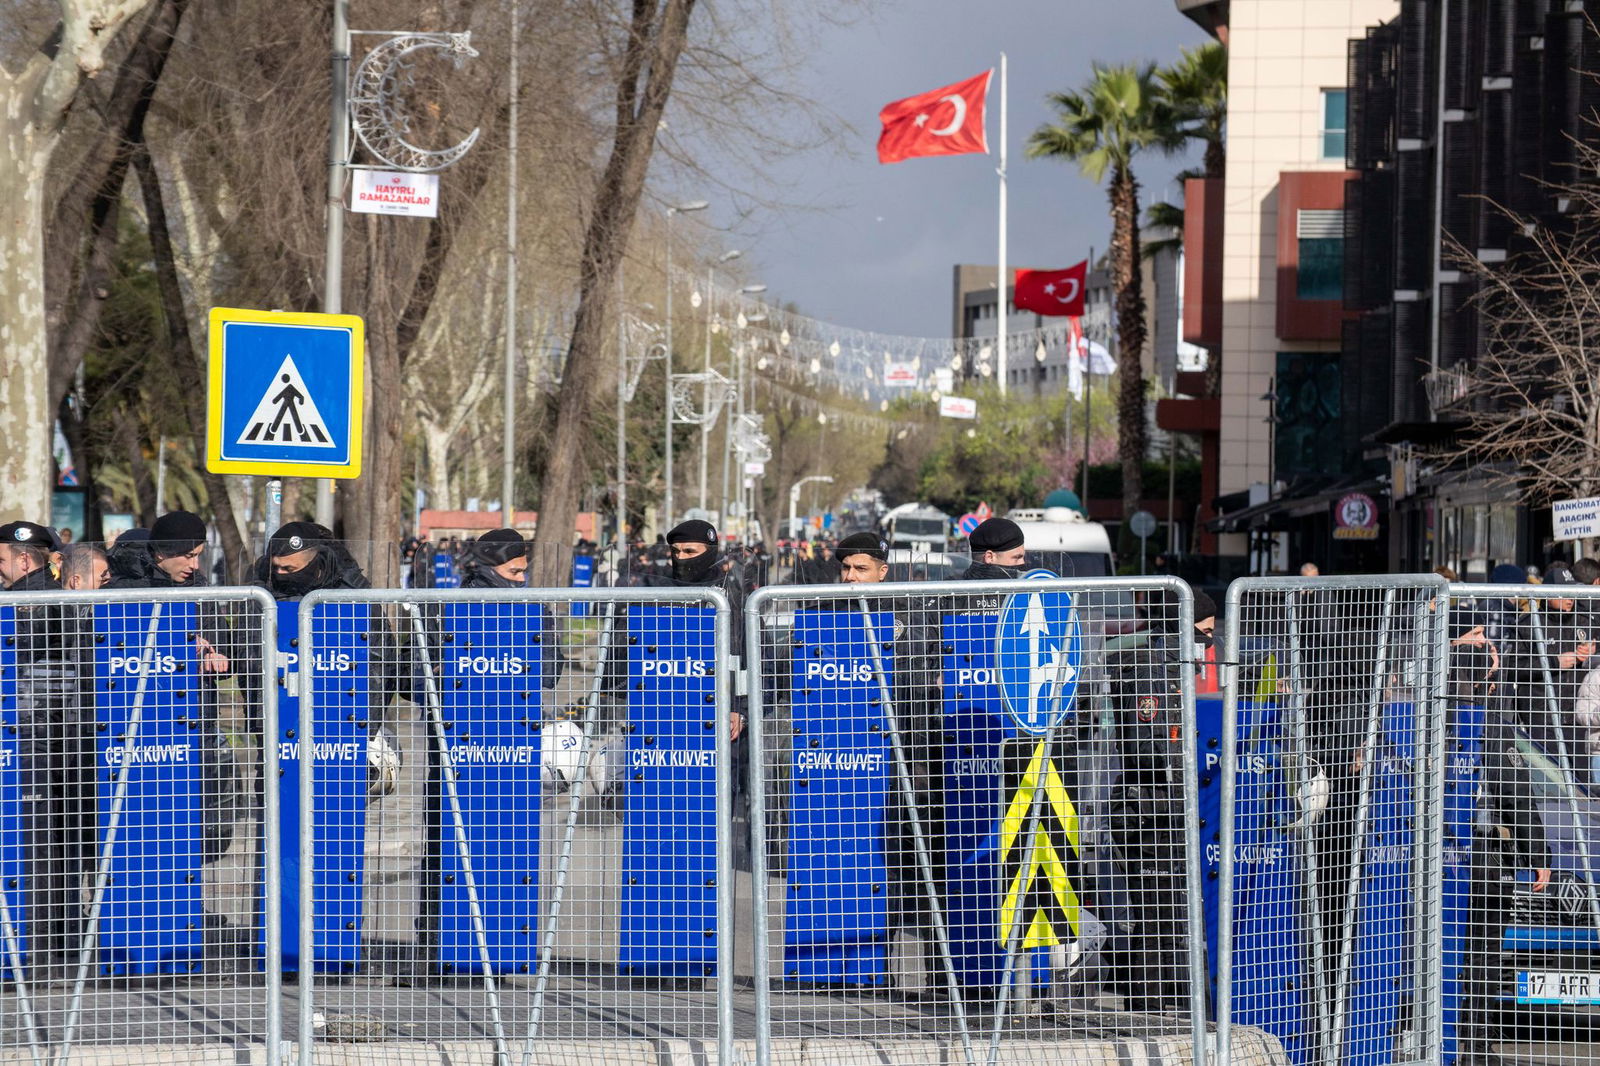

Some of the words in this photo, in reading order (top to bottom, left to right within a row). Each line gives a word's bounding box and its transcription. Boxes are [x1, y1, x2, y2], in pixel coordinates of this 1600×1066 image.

[359, 193, 431, 205] RAMAZANLAR
[376, 185, 415, 194] HAYIRLI
[1554, 501, 1600, 512] BANKOMAT
[1564, 526, 1592, 536] AİTTİR
[287, 650, 351, 671] PLİS
[458, 653, 523, 674] POLİS
[642, 656, 706, 678] POLİS
[807, 660, 872, 682] POLİS
[959, 669, 998, 685] POL
[143, 744, 191, 763] KUVVET
[313, 742, 360, 760] KUVVET
[450, 741, 485, 763] ÇEVİK
[487, 746, 534, 763] KUVVET
[632, 745, 666, 770] ÇEVİK
[671, 750, 717, 766] KUVVET
[798, 751, 832, 773] ÇEVİK
[836, 753, 882, 771] KUVVET
[1206, 752, 1265, 774] PLİS
[1531, 976, 1545, 995] 17
[1560, 976, 1589, 995] AFR
